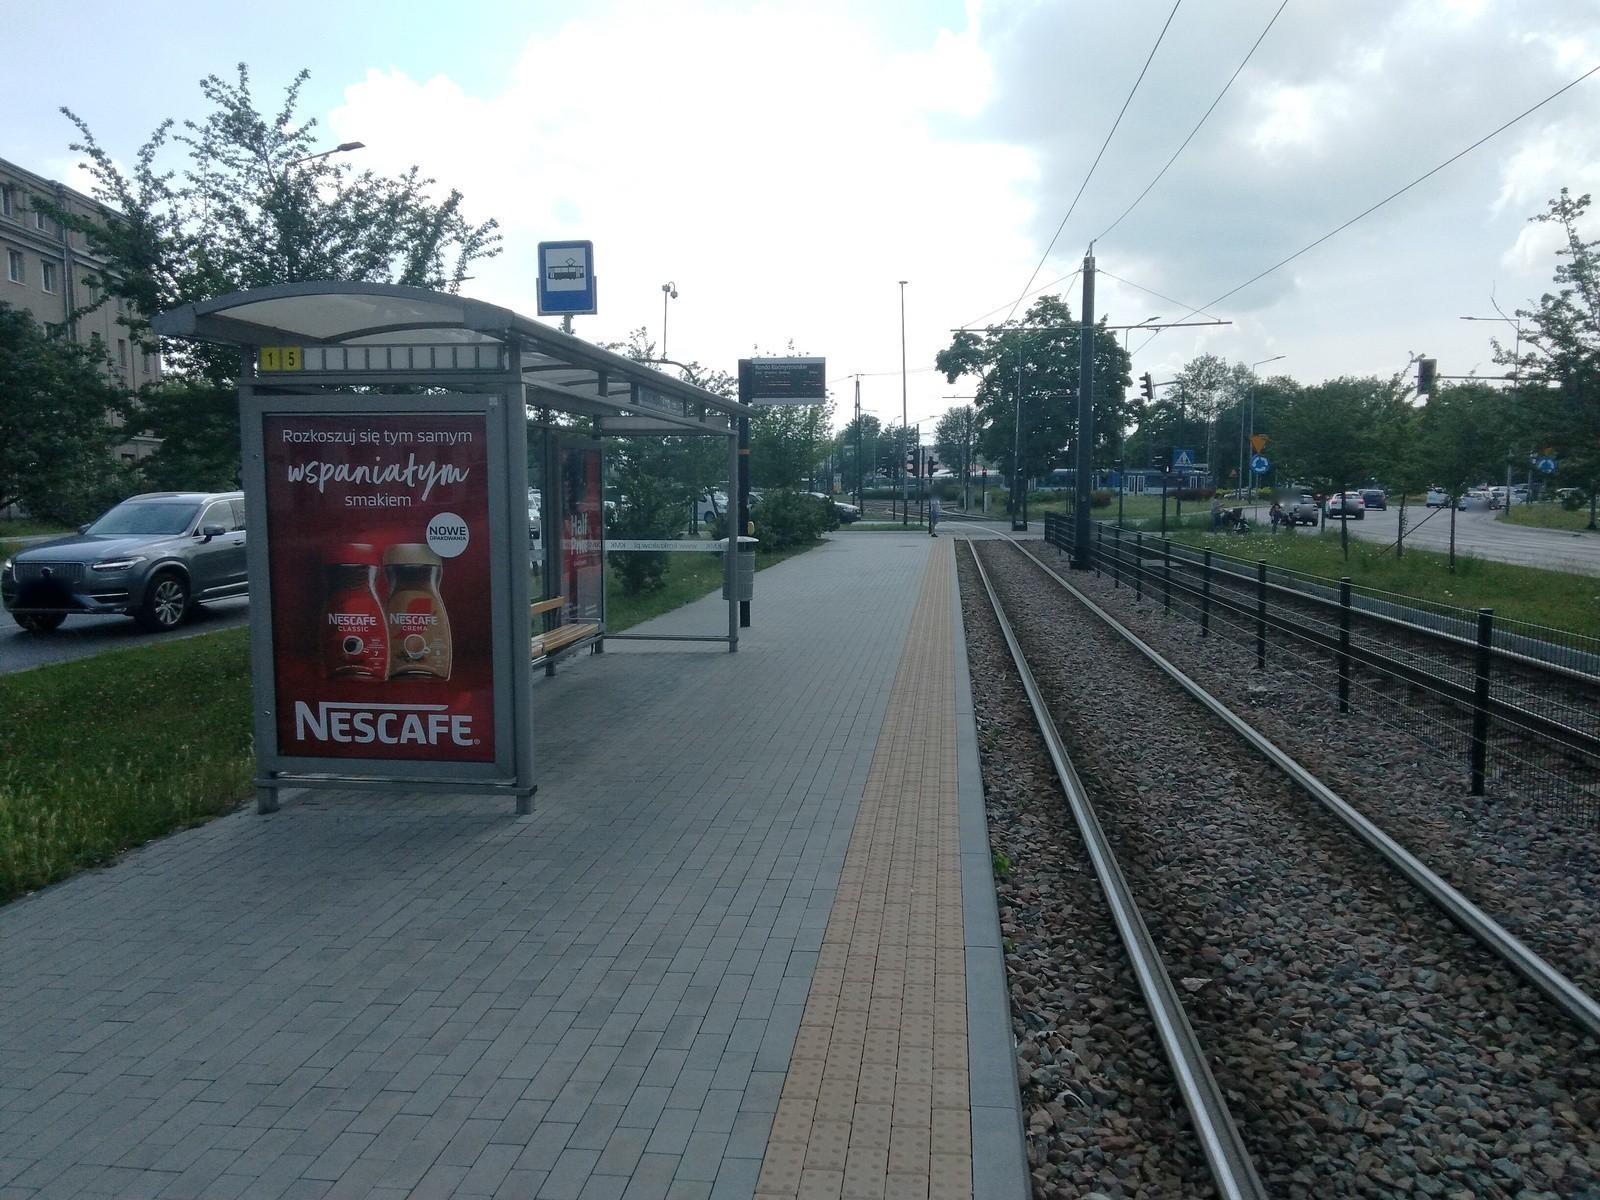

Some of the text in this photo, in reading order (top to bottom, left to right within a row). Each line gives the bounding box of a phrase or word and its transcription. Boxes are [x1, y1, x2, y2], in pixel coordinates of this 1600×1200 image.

[266, 352, 295, 366] 1 5
[282, 429, 473, 446] Rozkoszuj się tym samym
[287, 452, 470, 502] wspaniałym
[344, 493, 412, 508] smakiem
[429, 526, 466, 536] NOWE
[337, 625, 369, 633] CLASSIC
